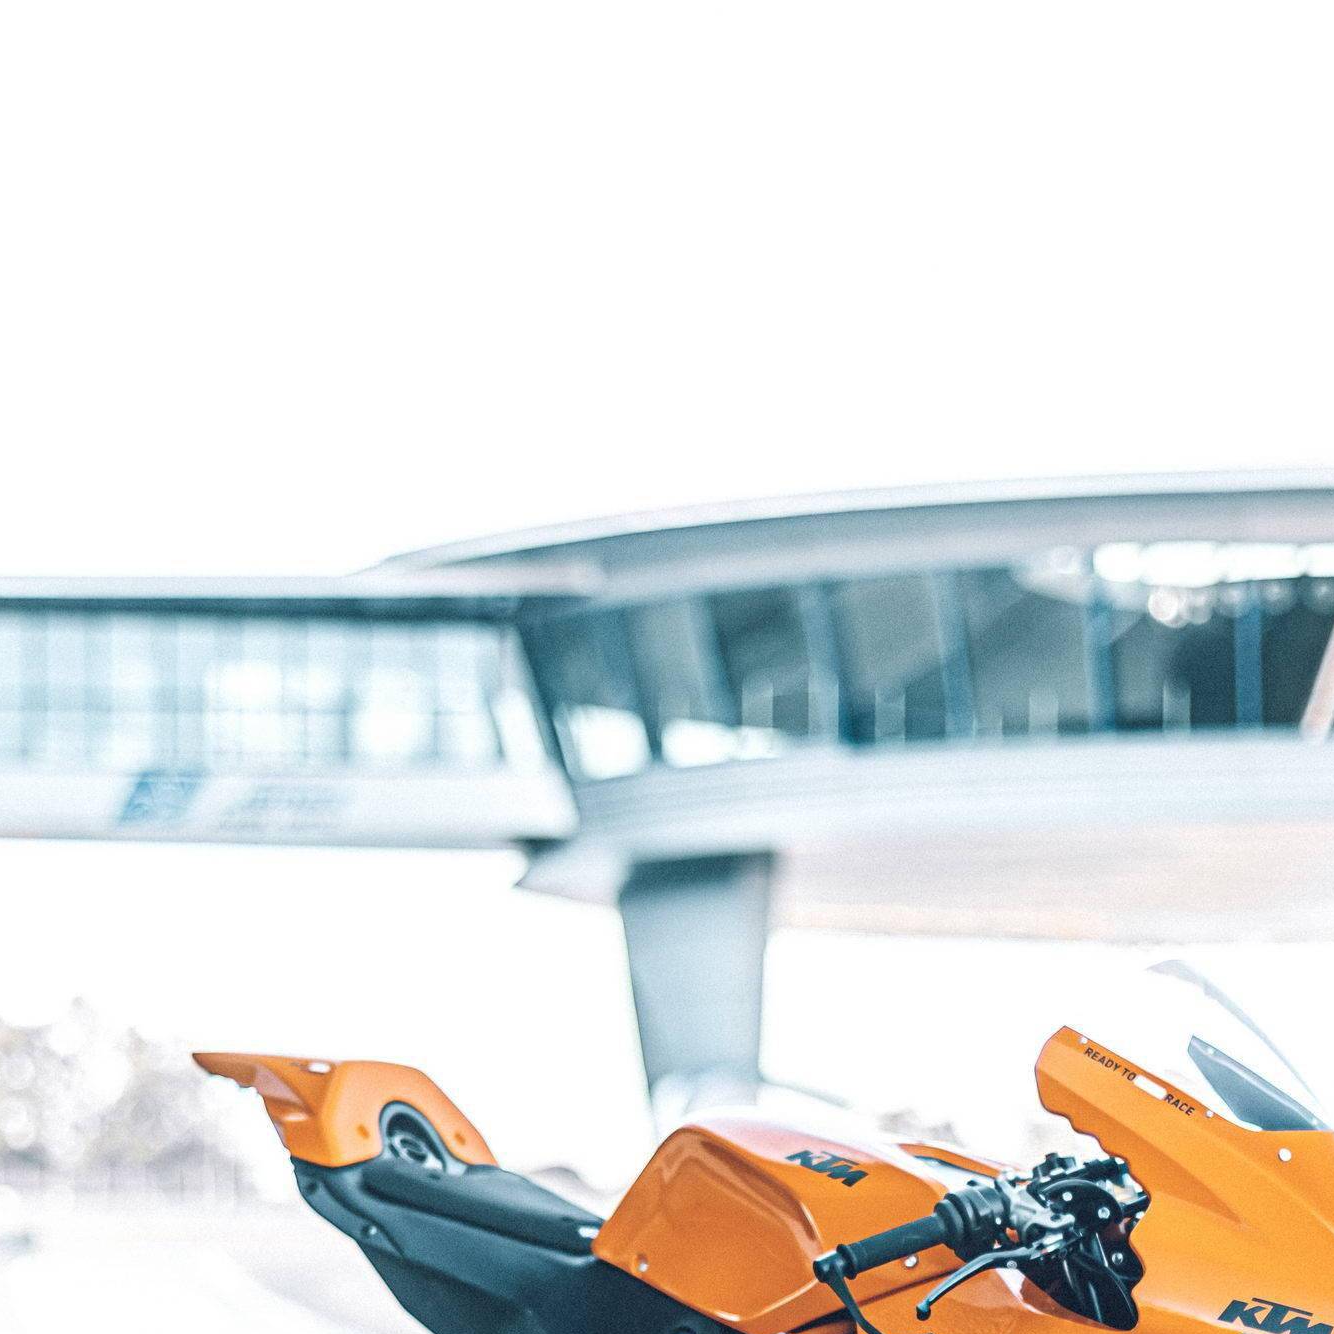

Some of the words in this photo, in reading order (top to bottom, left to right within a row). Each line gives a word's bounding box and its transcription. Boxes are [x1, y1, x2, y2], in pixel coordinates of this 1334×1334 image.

[1084, 1046, 1121, 1072] READY
[1122, 1067, 1137, 1082] TO
[1164, 1092, 1196, 1117] RACE
[784, 1149, 870, 1188] KTM
